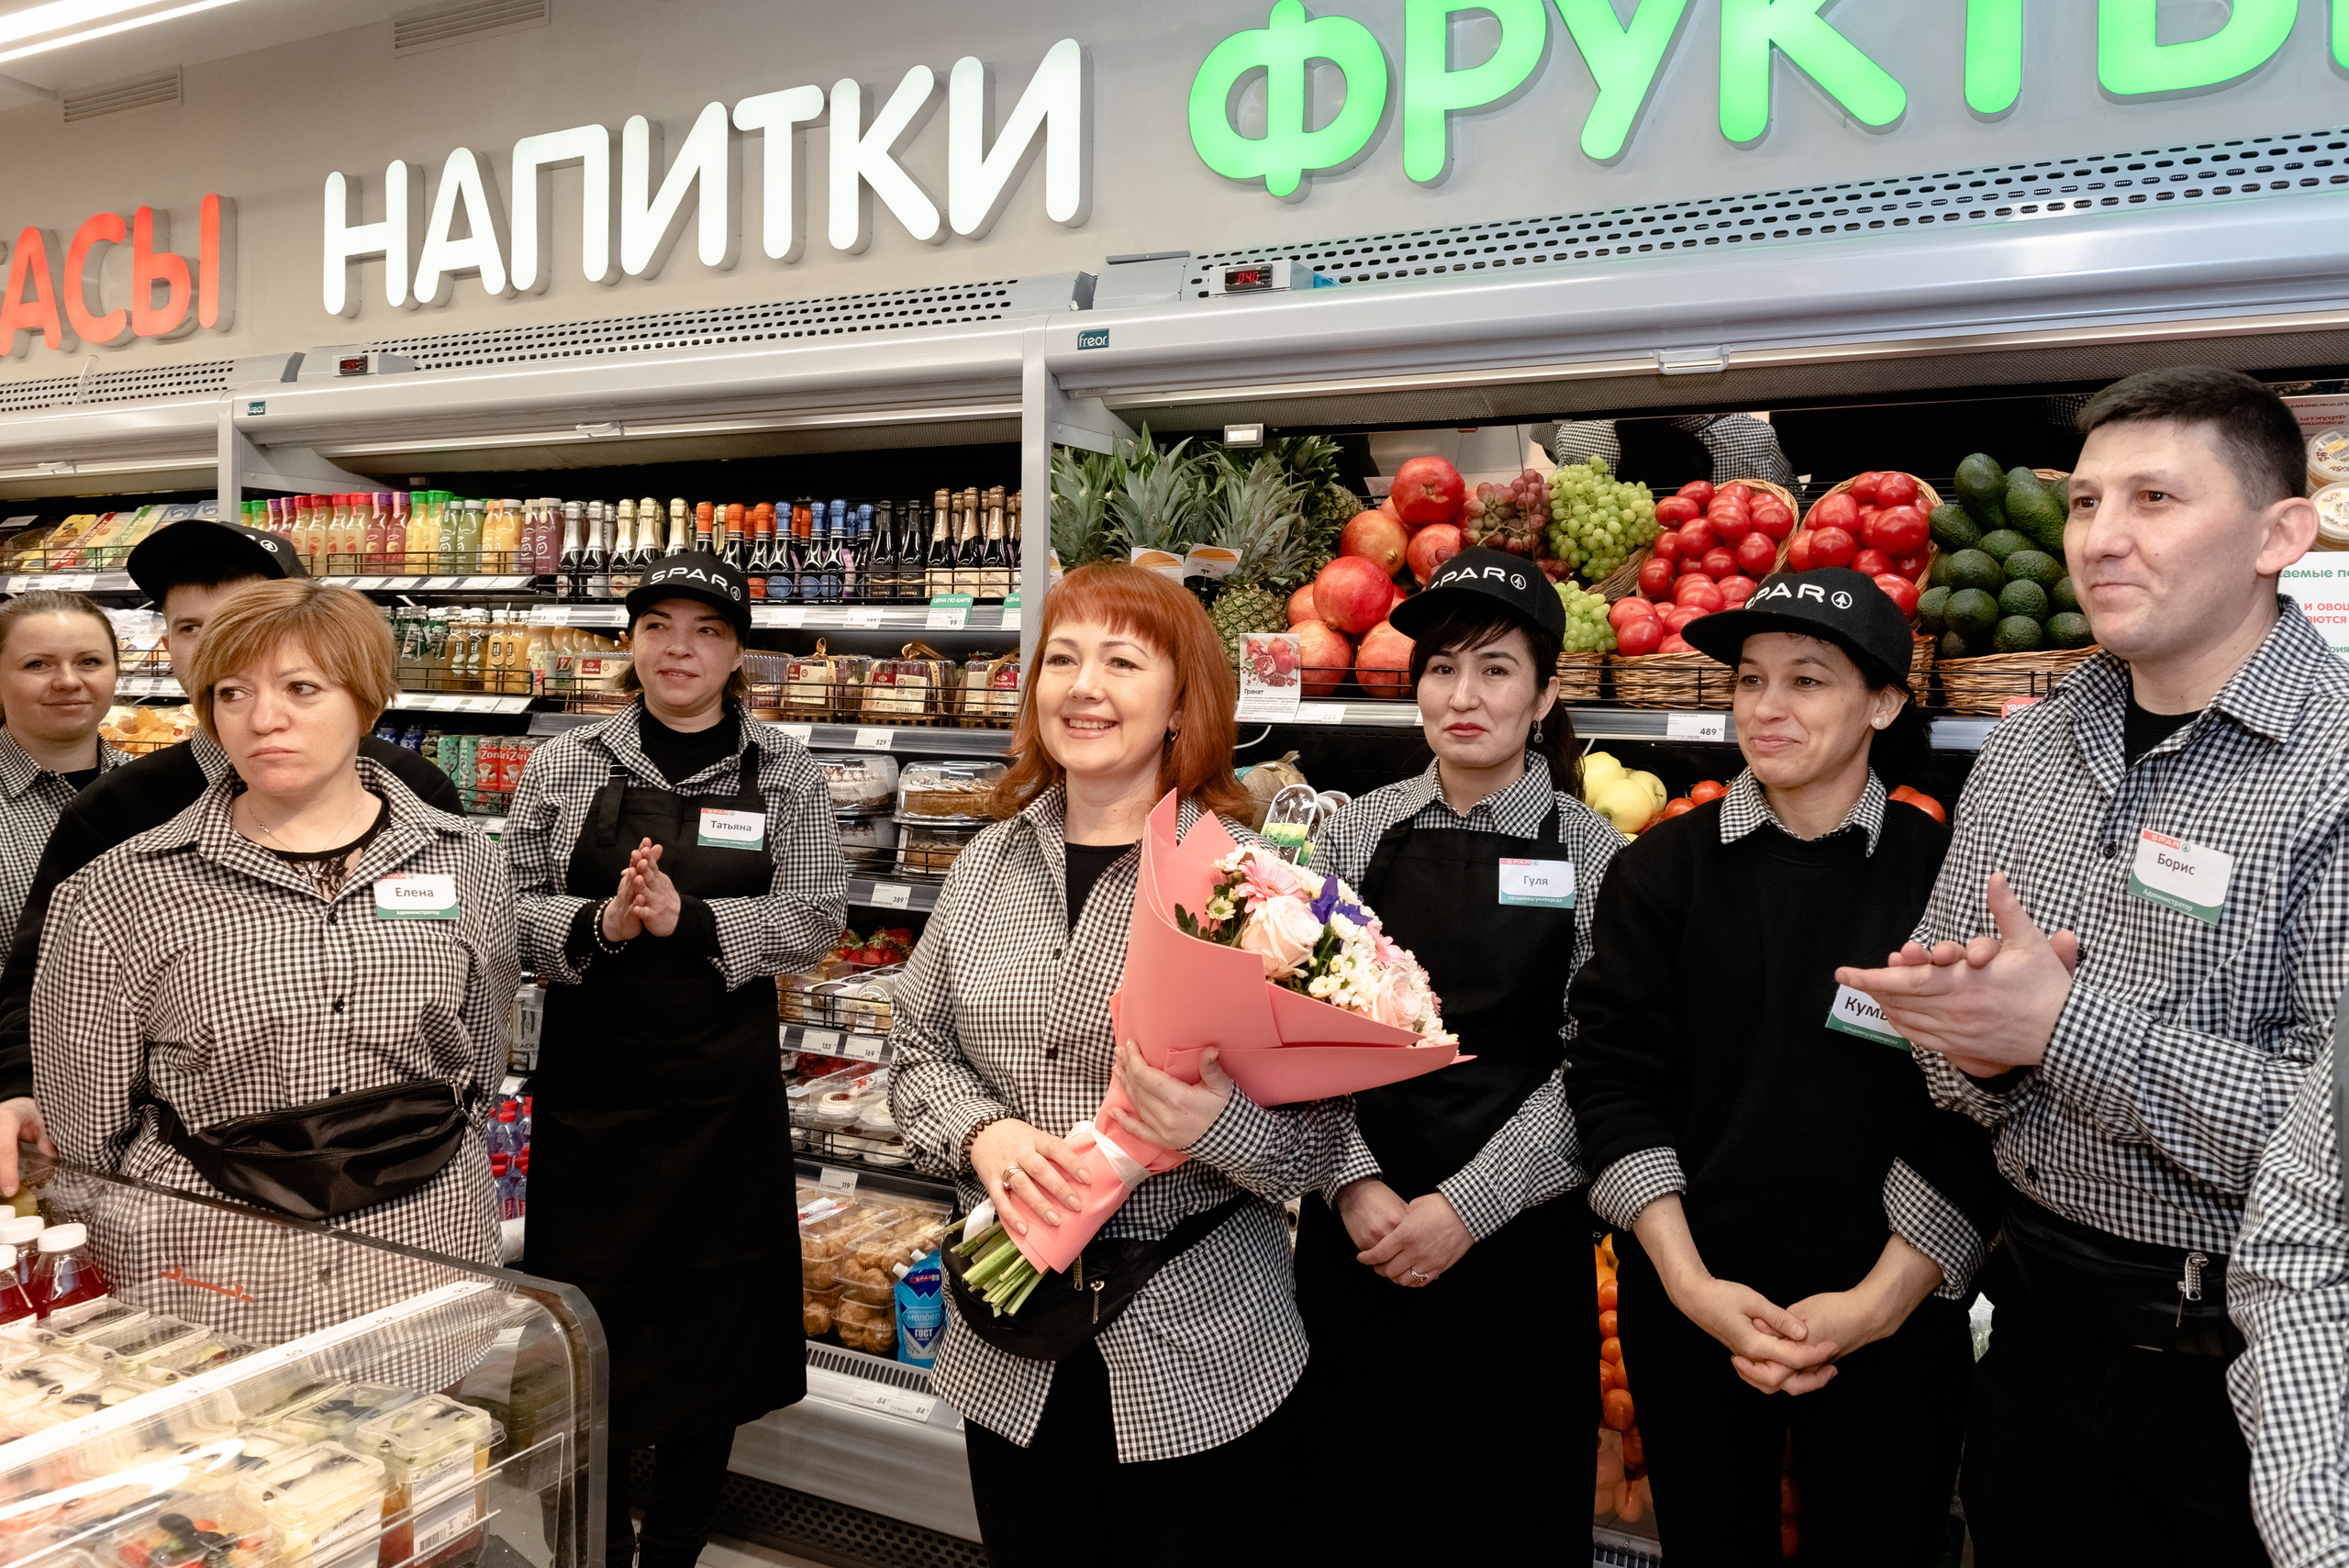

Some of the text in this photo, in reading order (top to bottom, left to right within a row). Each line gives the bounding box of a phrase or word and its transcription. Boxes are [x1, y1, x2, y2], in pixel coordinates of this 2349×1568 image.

[323, 39, 1081, 316] НАПИТКИ
[1079, 332, 1108, 348] freor
[1431, 566, 1506, 589] PAR
[2280, 569, 2332, 579] аемые
[650, 566, 728, 593] SPAR
[2304, 603, 2312, 611] и
[1700, 728, 1717, 736] 489
[710, 819, 752, 832] Татьяна
[2151, 834, 2180, 849] SPAR
[2157, 852, 2196, 875] Борис
[1523, 875, 1548, 887] Гуля
[395, 886, 434, 897] Елена
[893, 895, 905, 904] 389
[1508, 895, 1563, 904] продавец-универсал
[2143, 888, 2193, 913] Администратор
[1842, 1025, 1898, 1045] продавец-универсал
[865, 1049, 875, 1057] 169
[841, 1181, 851, 1189] 119
[907, 1313, 941, 1322] МОЛОКО
[914, 1329, 933, 1338] ГОСТ
[876, 1396, 886, 1406] 84
[916, 1407, 926, 1416] 84
